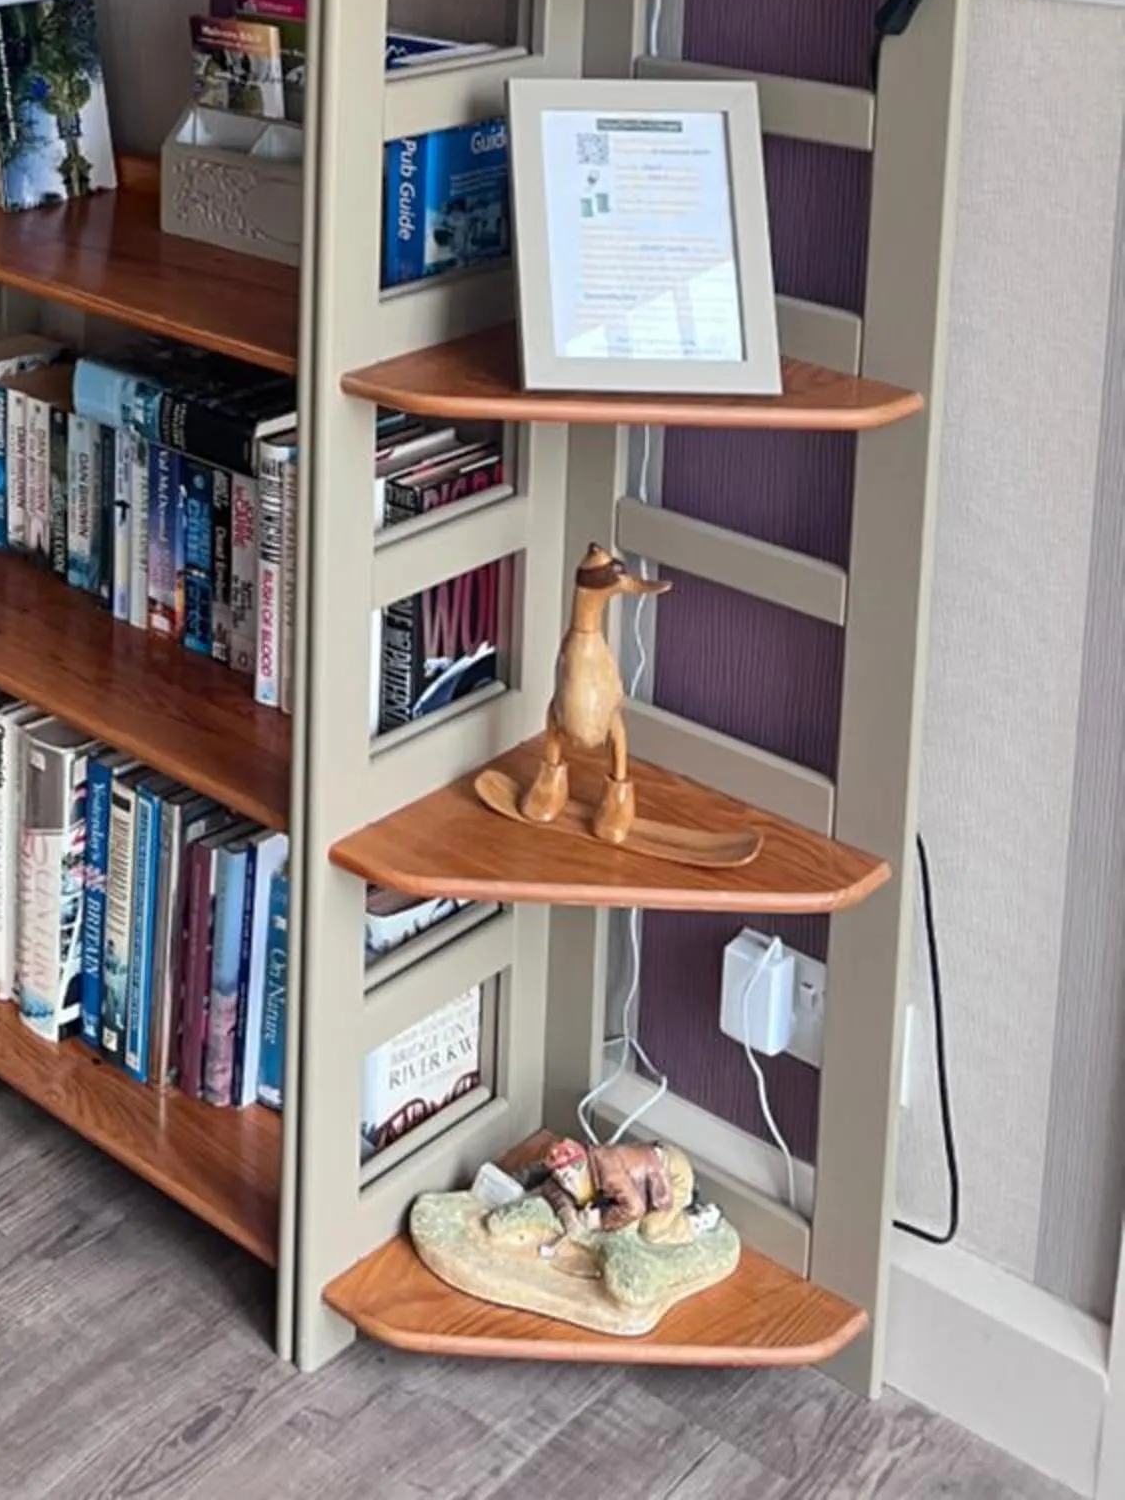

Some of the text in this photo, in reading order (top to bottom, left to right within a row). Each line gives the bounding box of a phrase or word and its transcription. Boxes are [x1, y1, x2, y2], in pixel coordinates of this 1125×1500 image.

[470, 124, 509, 155] Guid
[397, 139, 418, 241] Pub Guide
[83, 896, 102, 978] BRITAIN
[263, 947, 287, 1046] On Nature
